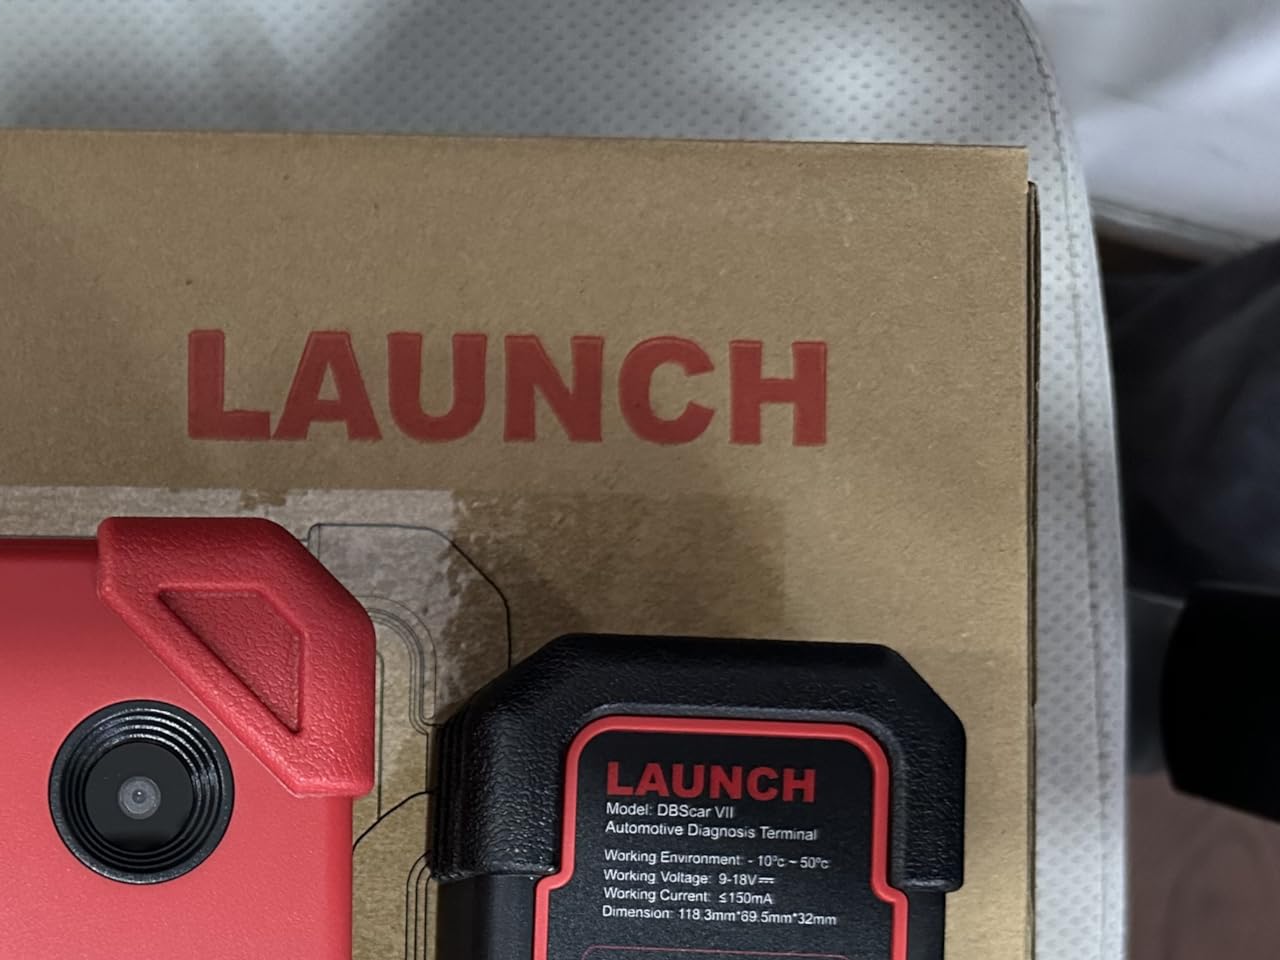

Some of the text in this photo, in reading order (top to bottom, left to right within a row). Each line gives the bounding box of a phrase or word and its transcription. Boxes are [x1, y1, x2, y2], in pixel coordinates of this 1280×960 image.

[187, 328, 829, 447] LAUNCH
[606, 761, 816, 803] LAUNCH
[606, 802, 734, 819] Model: DBScar VII
[605, 821, 817, 840] Automotive Diagnosis Terminal
[604, 849, 657, 864] Working
[603, 869, 656, 884] Working
[661, 871, 712, 886] Voltage:
[603, 887, 656, 903] Working
[659, 889, 711, 903] Current:
[602, 905, 674, 919] Dimension:
